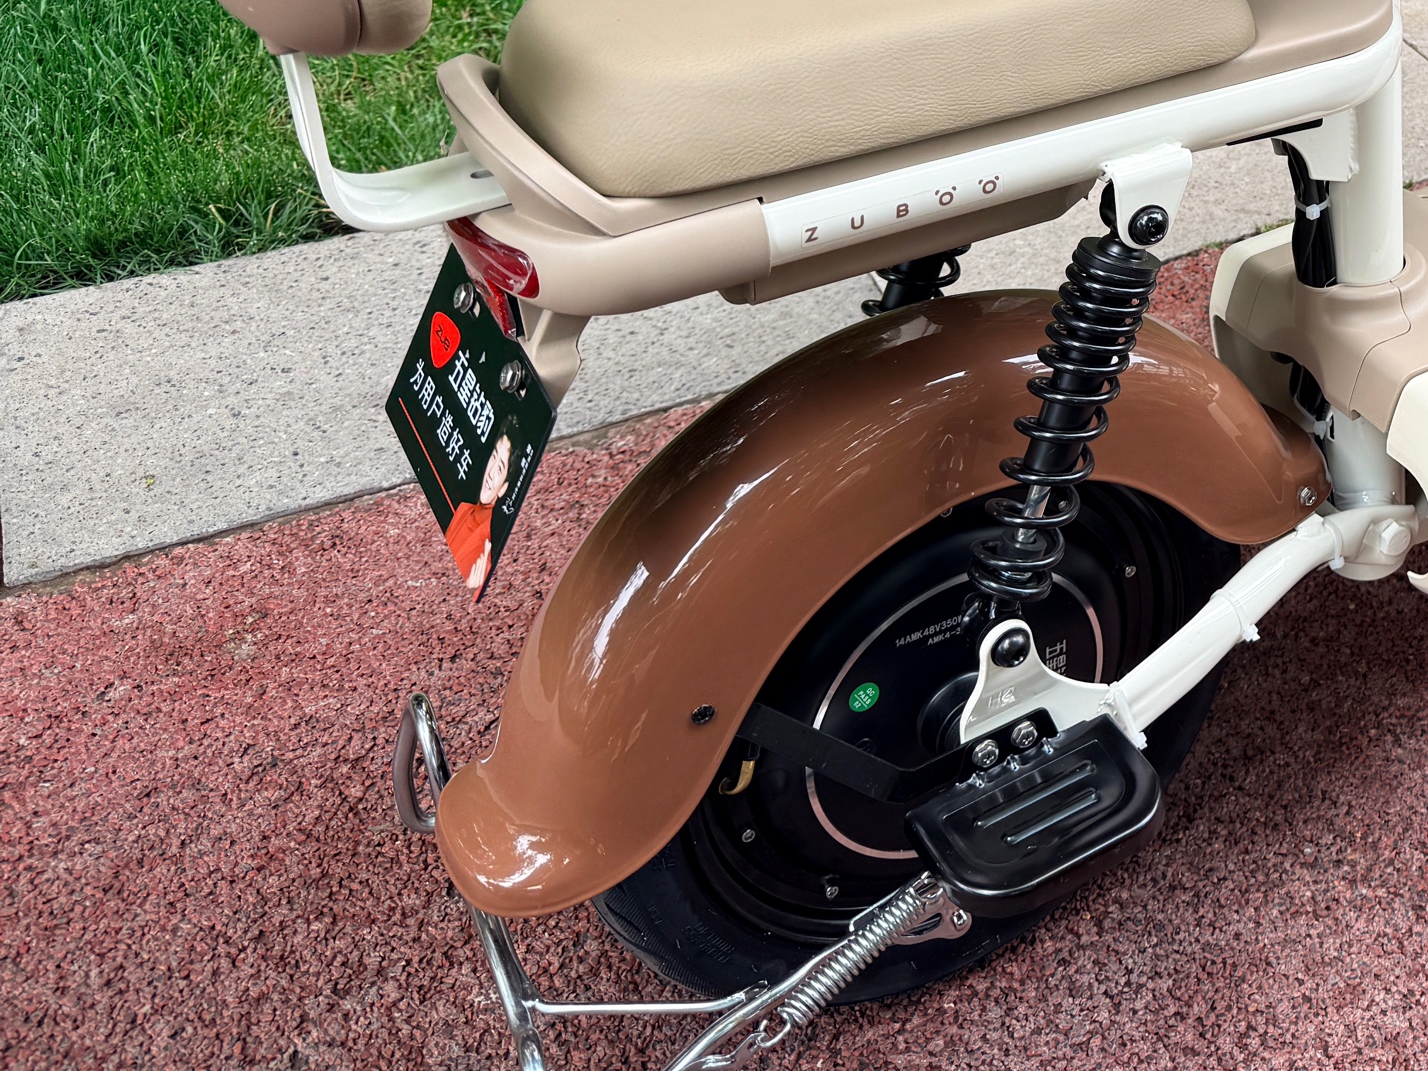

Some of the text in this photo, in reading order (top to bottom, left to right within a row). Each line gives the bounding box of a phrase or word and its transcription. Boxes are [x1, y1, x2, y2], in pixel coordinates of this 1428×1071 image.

[409, 358, 473, 481] 为用户造好车
[448, 351, 495, 444] 五星钻豹
[857, 690, 872, 705] PASS
